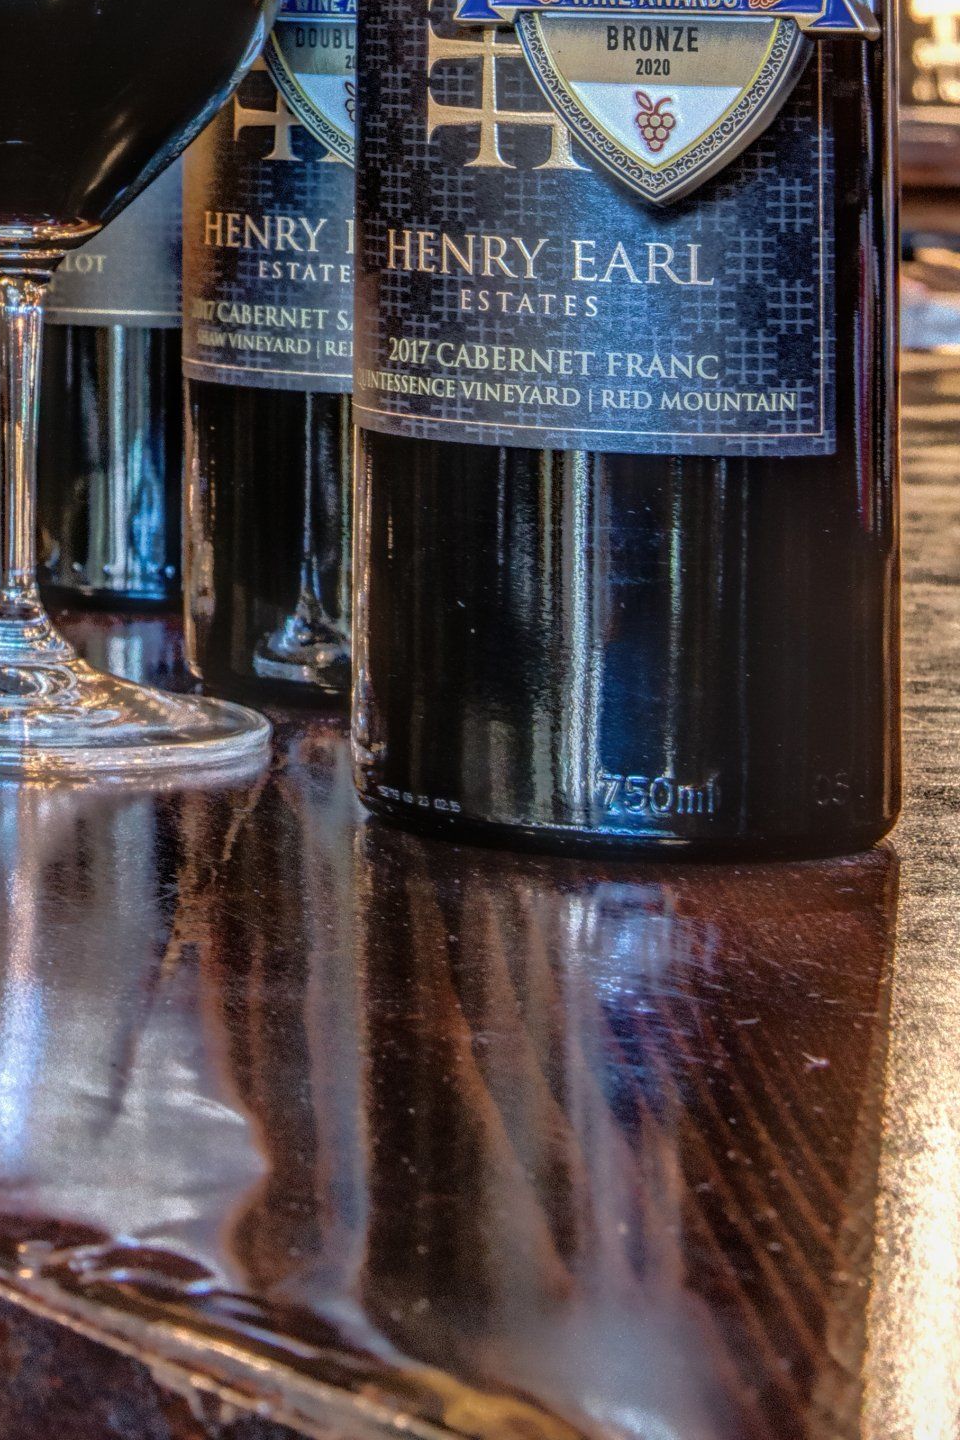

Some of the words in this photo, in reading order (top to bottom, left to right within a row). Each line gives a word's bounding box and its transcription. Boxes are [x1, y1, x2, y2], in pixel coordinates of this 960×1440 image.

[295, 26, 355, 50] DOUBL
[606, 25, 700, 53] BRONZE
[635, 58, 671, 77] 2020
[203, 210, 328, 253] HENRY
[65, 253, 107, 273] LOT
[387, 227, 550, 280] HENRY
[571, 239, 715, 287] EARL
[258, 260, 355, 283] ESTATE
[217, 302, 330, 330] CABERNET
[461, 289, 598, 318] ESTATES
[228, 333, 312, 355] VINEYARD
[388, 337, 430, 364] 2017
[436, 342, 596, 377] CABERNET
[607, 352, 720, 381] FRANC
[357, 367, 456, 399] QUINTESSENCE
[460, 380, 581, 408] VINEYARD
[601, 389, 654, 411] RED
[661, 390, 797, 413] MOUNTAIN
[601, 773, 720, 815] 750ml
